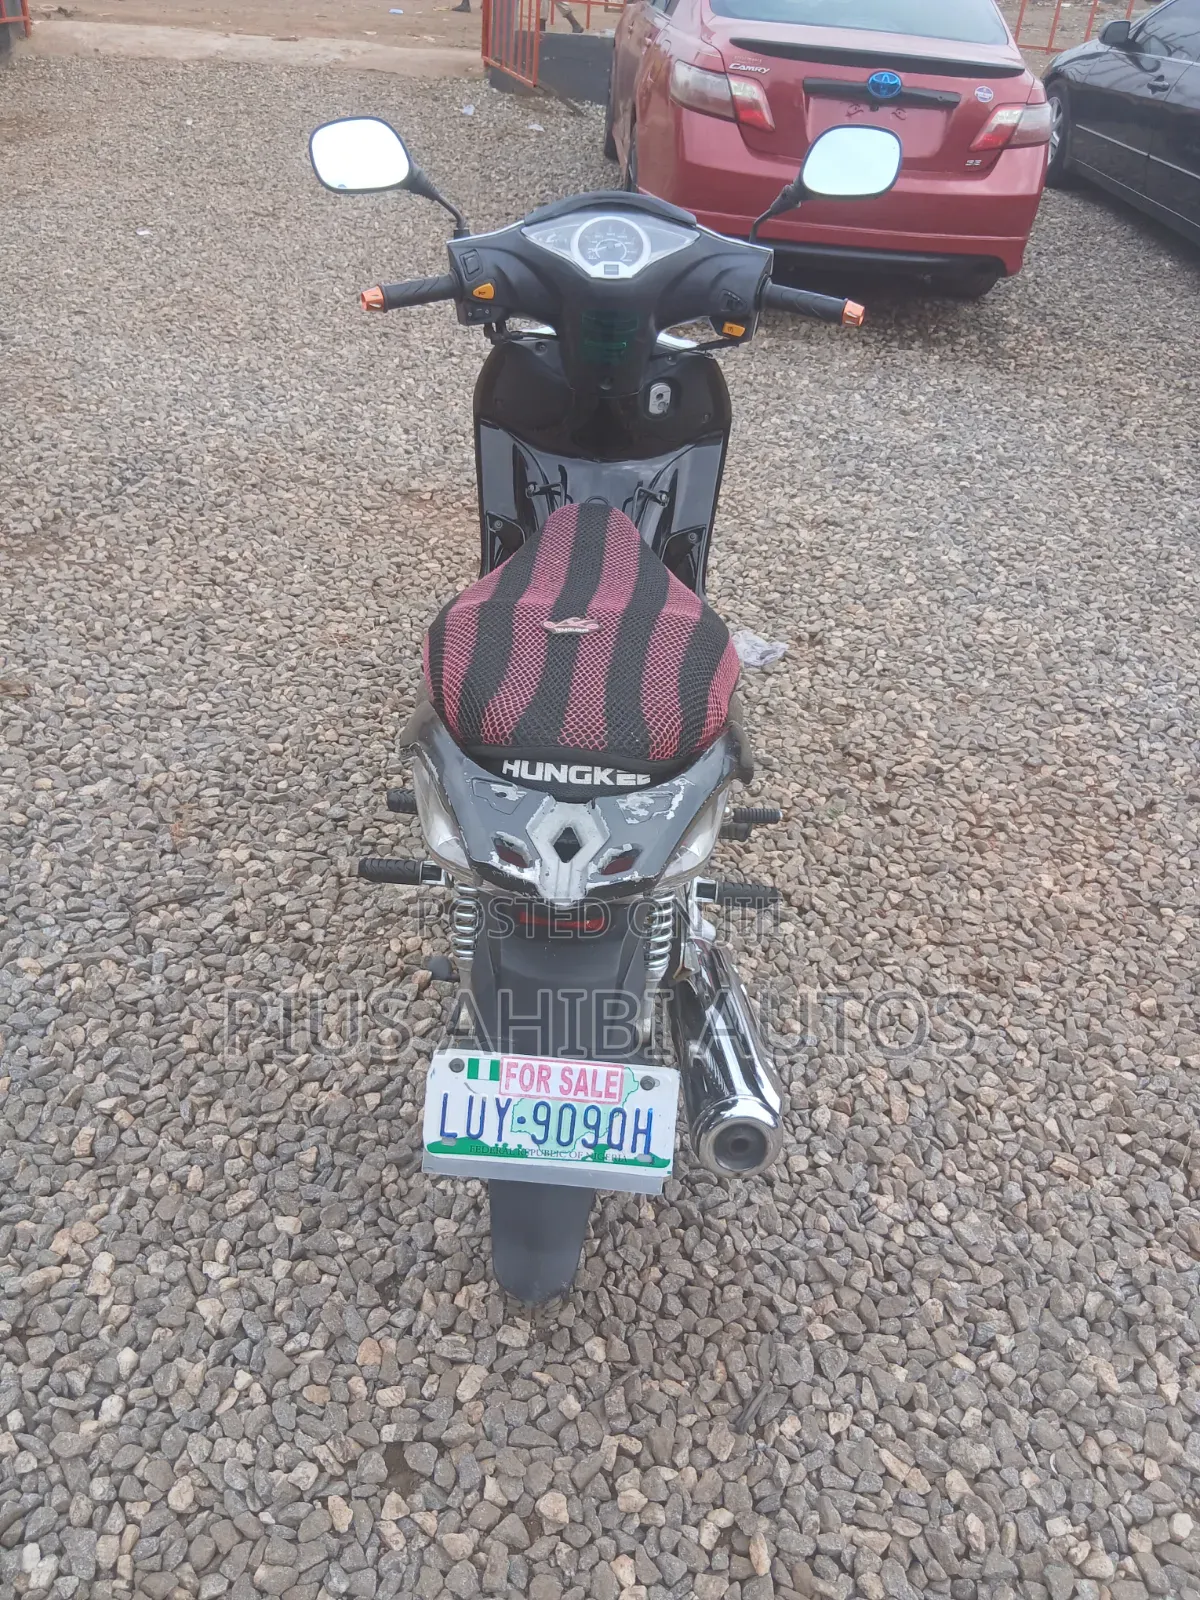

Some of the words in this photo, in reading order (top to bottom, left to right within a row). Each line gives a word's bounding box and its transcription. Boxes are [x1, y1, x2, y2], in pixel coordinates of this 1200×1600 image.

[729, 62, 771, 74] CAMRY
[504, 1061, 552, 1094] FOR
[558, 1066, 620, 1100] SALE
[469, 1144, 515, 1155] FEDERAL
[516, 1147, 567, 1159] REPUBLIC
[568, 1150, 583, 1159] OF
[585, 1152, 628, 1163] NIGERIA
